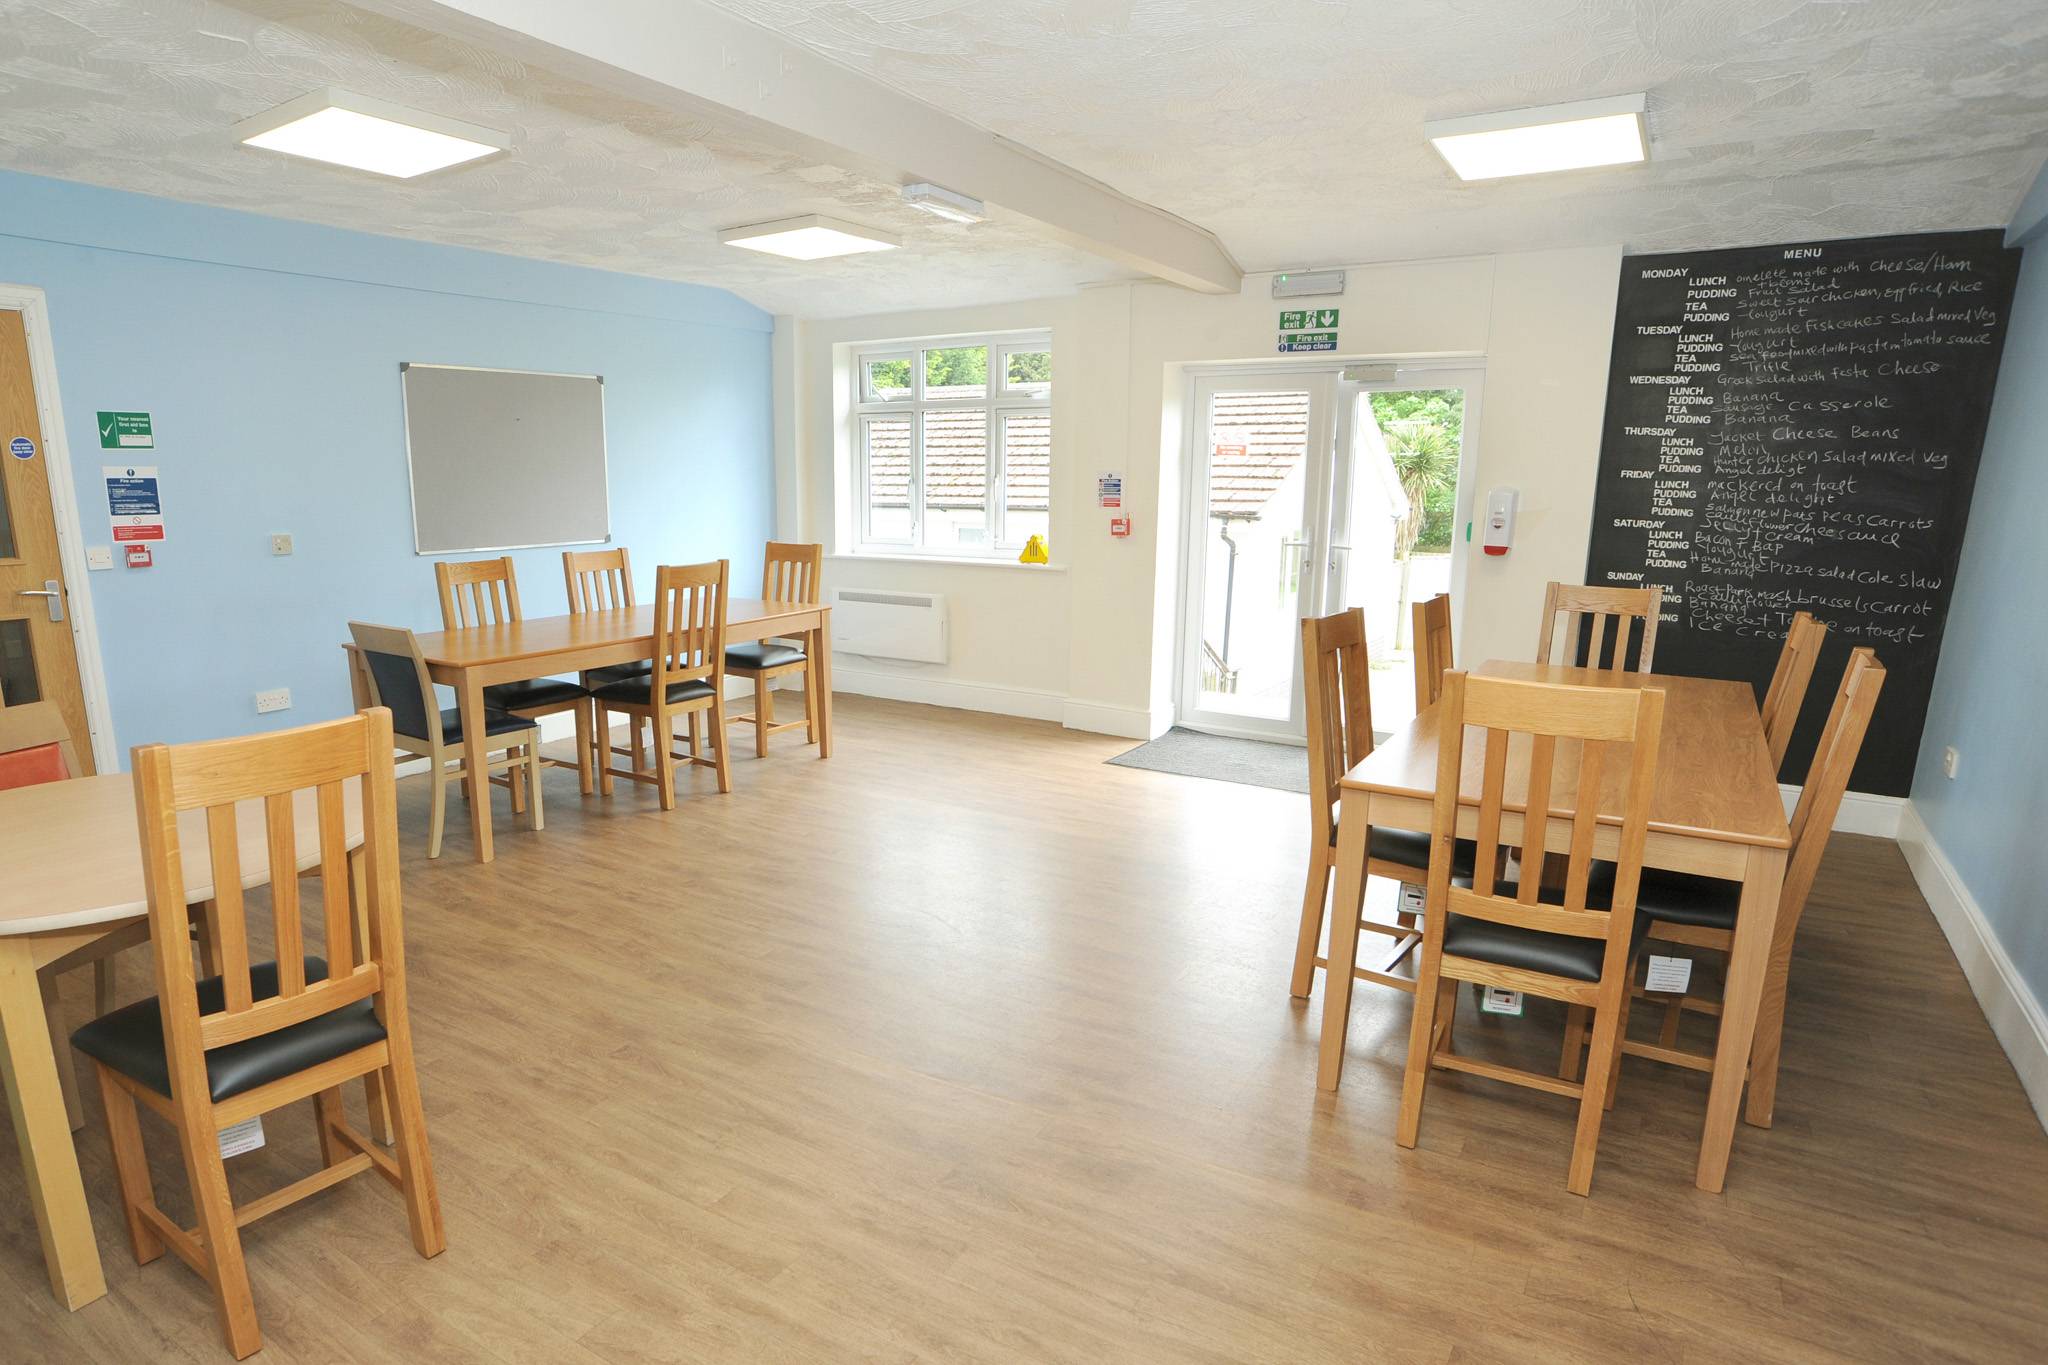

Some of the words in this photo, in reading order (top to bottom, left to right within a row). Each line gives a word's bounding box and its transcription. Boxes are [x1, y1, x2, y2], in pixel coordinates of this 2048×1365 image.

[1784, 248, 1822, 259] MENU
[1642, 268, 1689, 279] MONDAY
[1793, 267, 1827, 278] made
[1834, 262, 1859, 274] with
[1689, 276, 1727, 286] LUNCH
[1948, 282, 1982, 293] Rice
[1687, 288, 1737, 299] PUDDING
[1685, 302, 1708, 311] TEA
[1683, 313, 1730, 322] PUDDING
[1284, 320, 1300, 328] exit
[1636, 325, 1683, 335] TUESDAY
[1731, 326, 1760, 339] Home
[1764, 323, 1800, 335] made
[1678, 334, 1713, 343] LUNCH
[1947, 333, 1991, 344] sauce
[1677, 344, 1723, 353] PUDDING
[1675, 354, 1697, 363] TEA
[1674, 363, 1720, 372] PUDDING
[1630, 375, 1691, 385] WEDNESDAY
[1669, 387, 1704, 396] LUNCH
[1668, 396, 1714, 405] PUDDING
[1723, 392, 1784, 404] Banana
[1666, 406, 1687, 414] TEA
[1665, 415, 1711, 424] PUDDING
[1725, 414, 1795, 425] Banana
[1624, 427, 1677, 437] THURSDAY
[1772, 427, 1837, 440] Cheese
[1852, 426, 1900, 439] Beans
[1661, 438, 1694, 446] LUNCH
[1660, 447, 1704, 456] PUDDING
[1660, 455, 1680, 464] TEA
[1923, 451, 1948, 469] Veg
[1658, 464, 1702, 473] PUDDING
[1620, 470, 1655, 479] FRIDAY
[1654, 480, 1689, 489] LUNCH
[1790, 482, 1803, 492] on
[1653, 489, 1696, 499] PUDDING
[1652, 498, 1672, 506] TEA
[1651, 506, 1693, 517] PUDDING
[1613, 518, 1666, 529] SATURDAY
[1649, 530, 1683, 539] LUNCH
[1648, 540, 1690, 550] PUDDING
[1695, 531, 1731, 546] Bacon
[1752, 540, 1783, 555] Bap
[1647, 549, 1666, 558] TEA
[1645, 559, 1687, 569] PUDDING
[1607, 571, 1645, 582] SUNDAY
[1858, 570, 1893, 584] Cole
[1736, 627, 1789, 639] Crea
[1844, 625, 1860, 635] on
